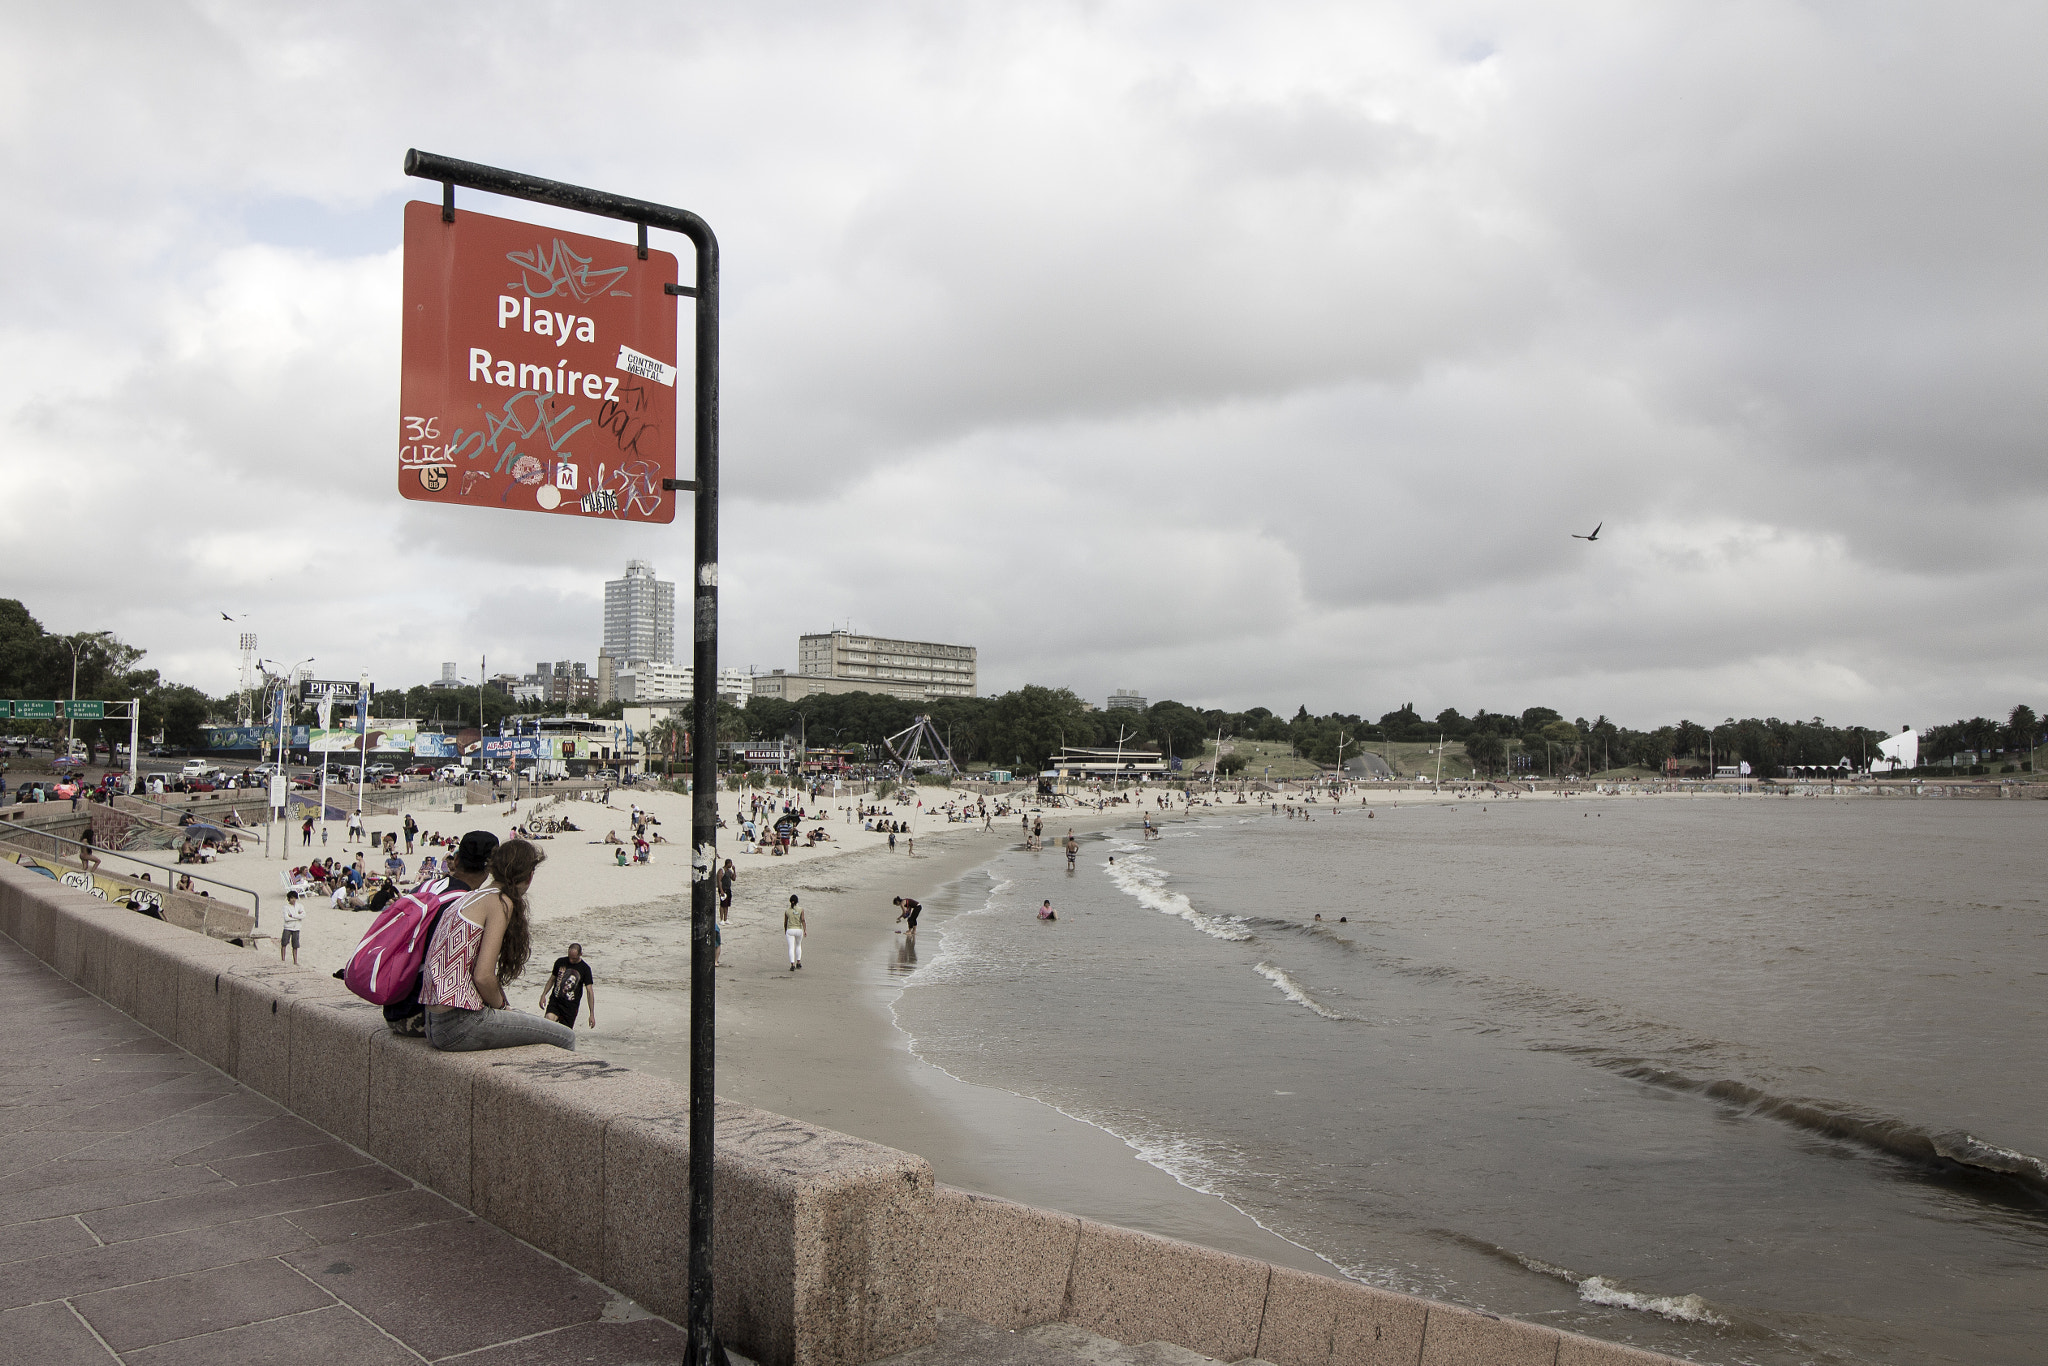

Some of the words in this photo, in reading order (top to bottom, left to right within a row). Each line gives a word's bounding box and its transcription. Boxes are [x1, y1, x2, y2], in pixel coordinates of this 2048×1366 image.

[498, 295, 595, 347] Playa
[627, 354, 664, 374] CONTROL
[627, 363, 661, 382] MENTAL
[469, 348, 620, 402] Ramírez
[403, 416, 440, 441] 36
[399, 444, 457, 464] CLICK
[562, 473, 573, 486] M
